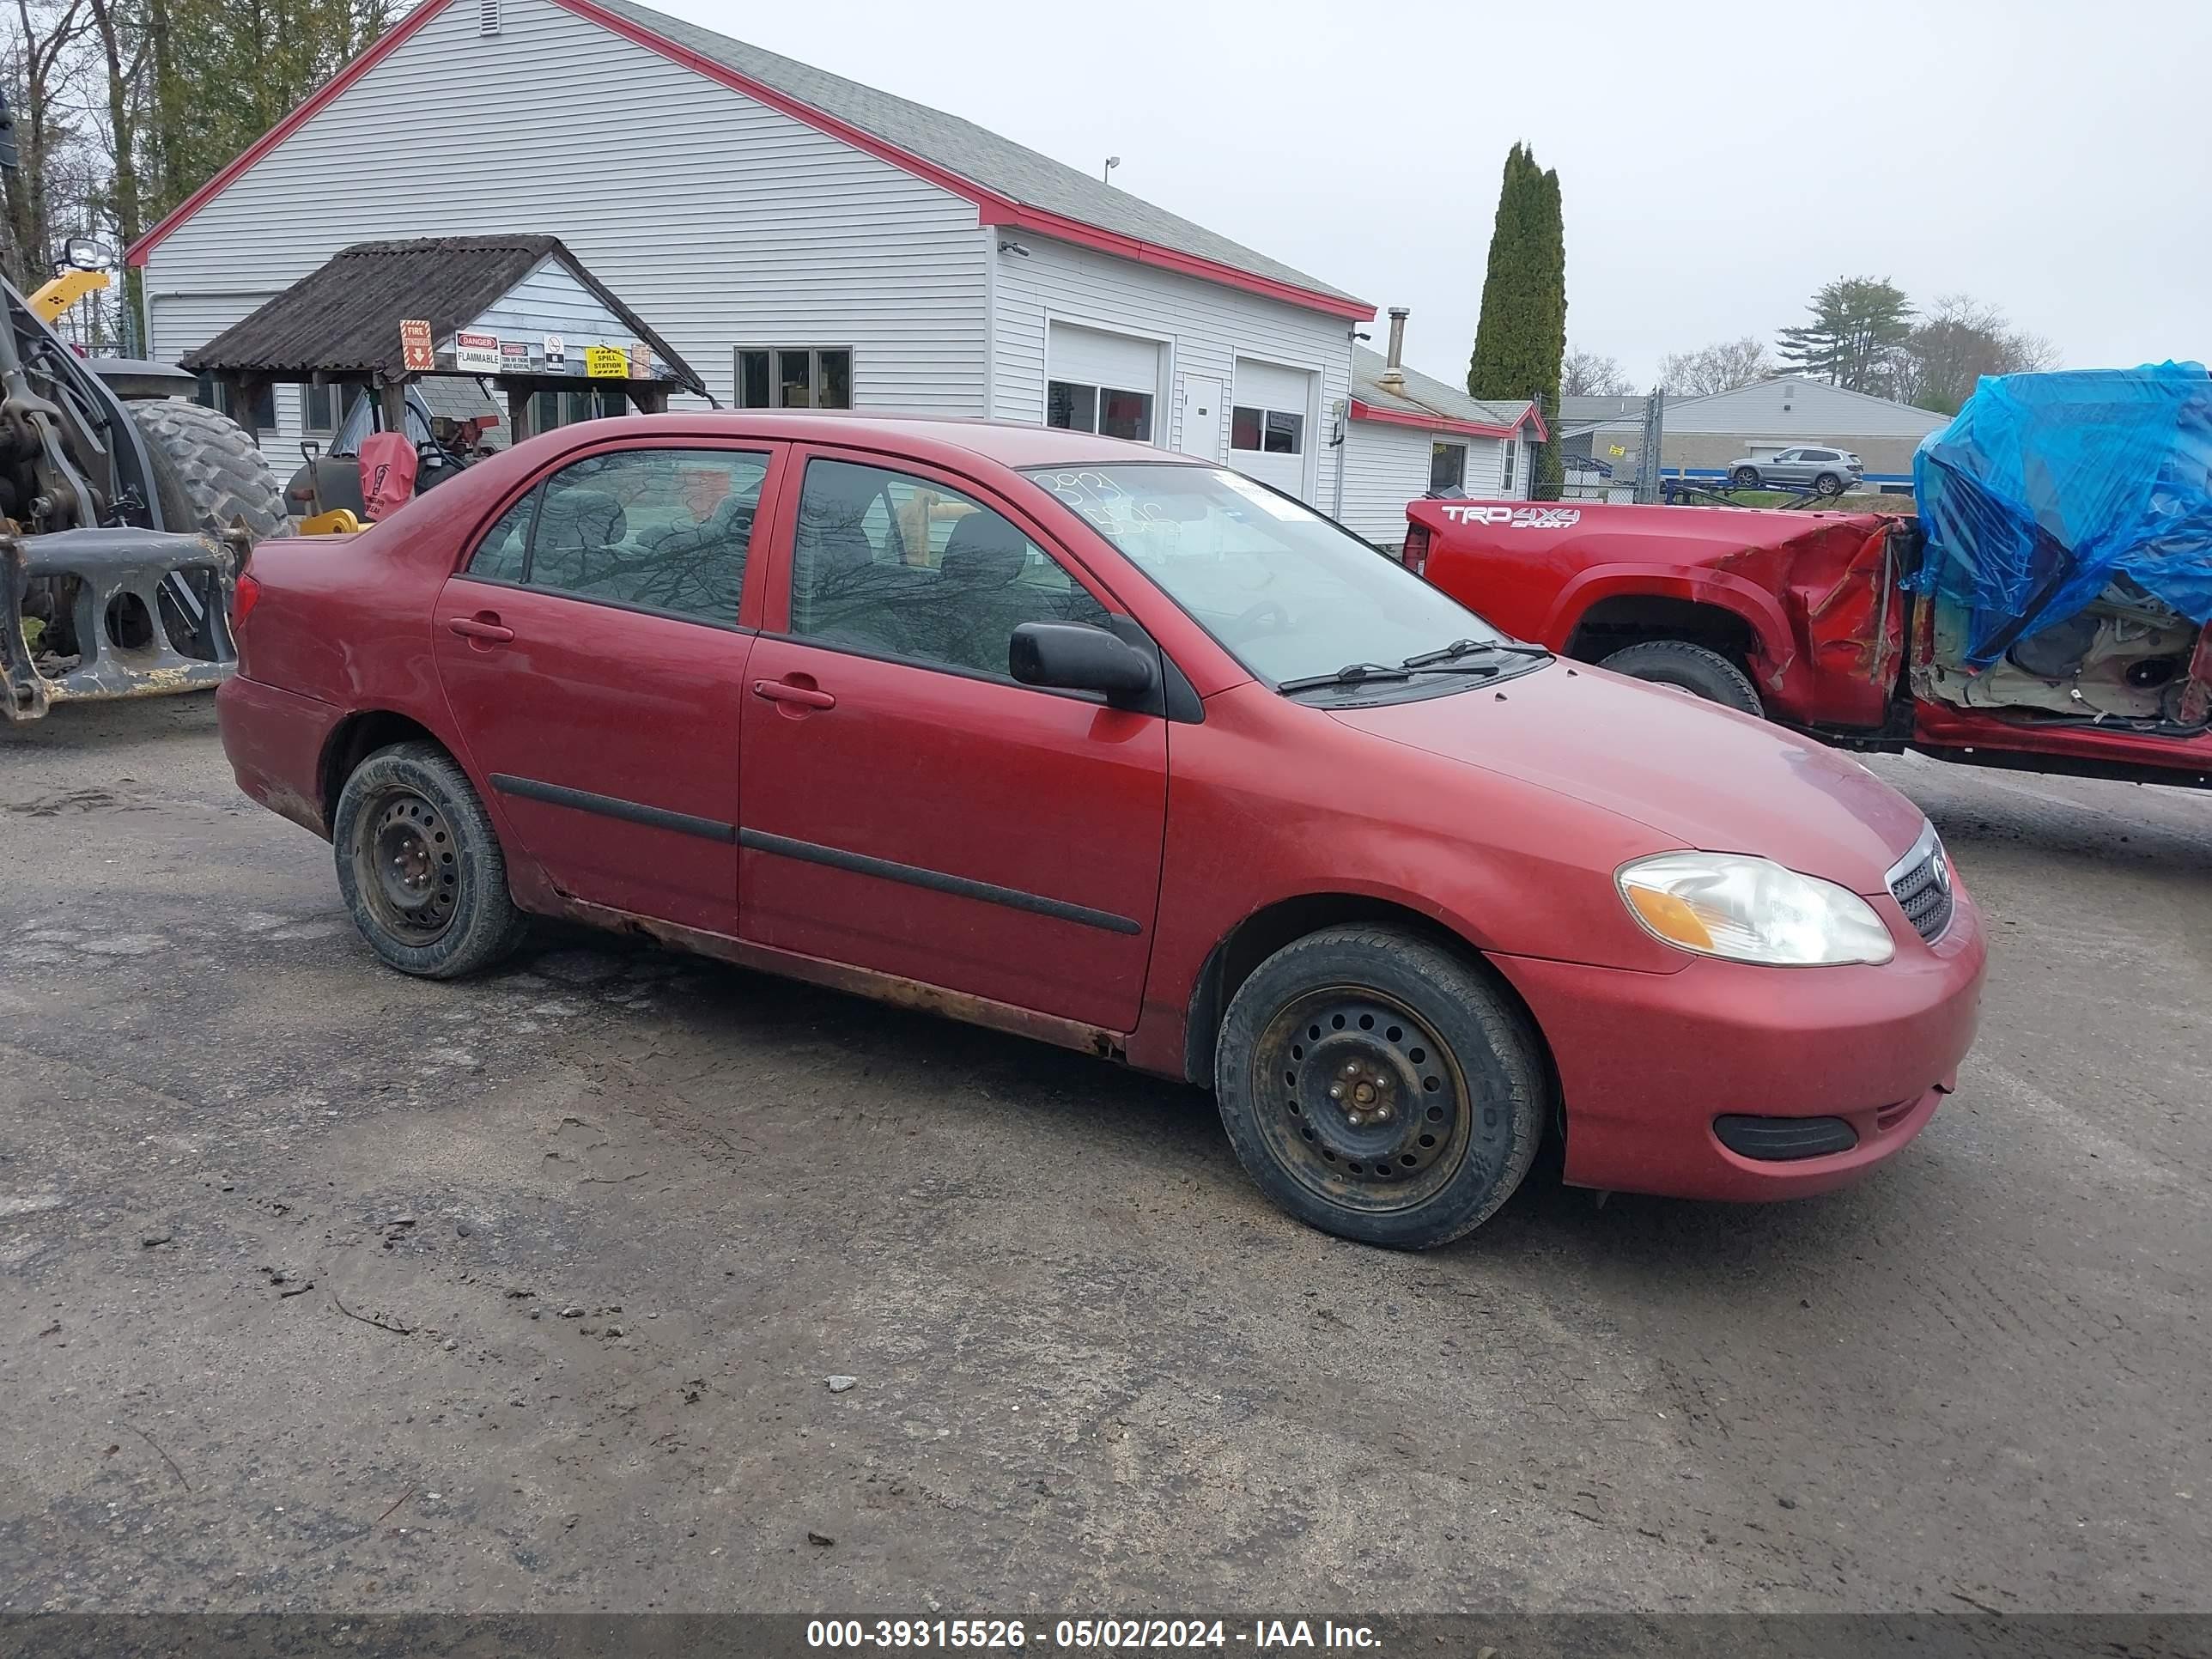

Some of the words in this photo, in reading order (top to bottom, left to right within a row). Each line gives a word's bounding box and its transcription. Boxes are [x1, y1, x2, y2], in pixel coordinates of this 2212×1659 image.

[408, 326, 424, 336] FIRE
[463, 337, 493, 348] DANGER
[458, 351, 499, 365] FLAMMABLE
[1442, 506, 1514, 526] TRD
[1510, 520, 1577, 529] SPORT
